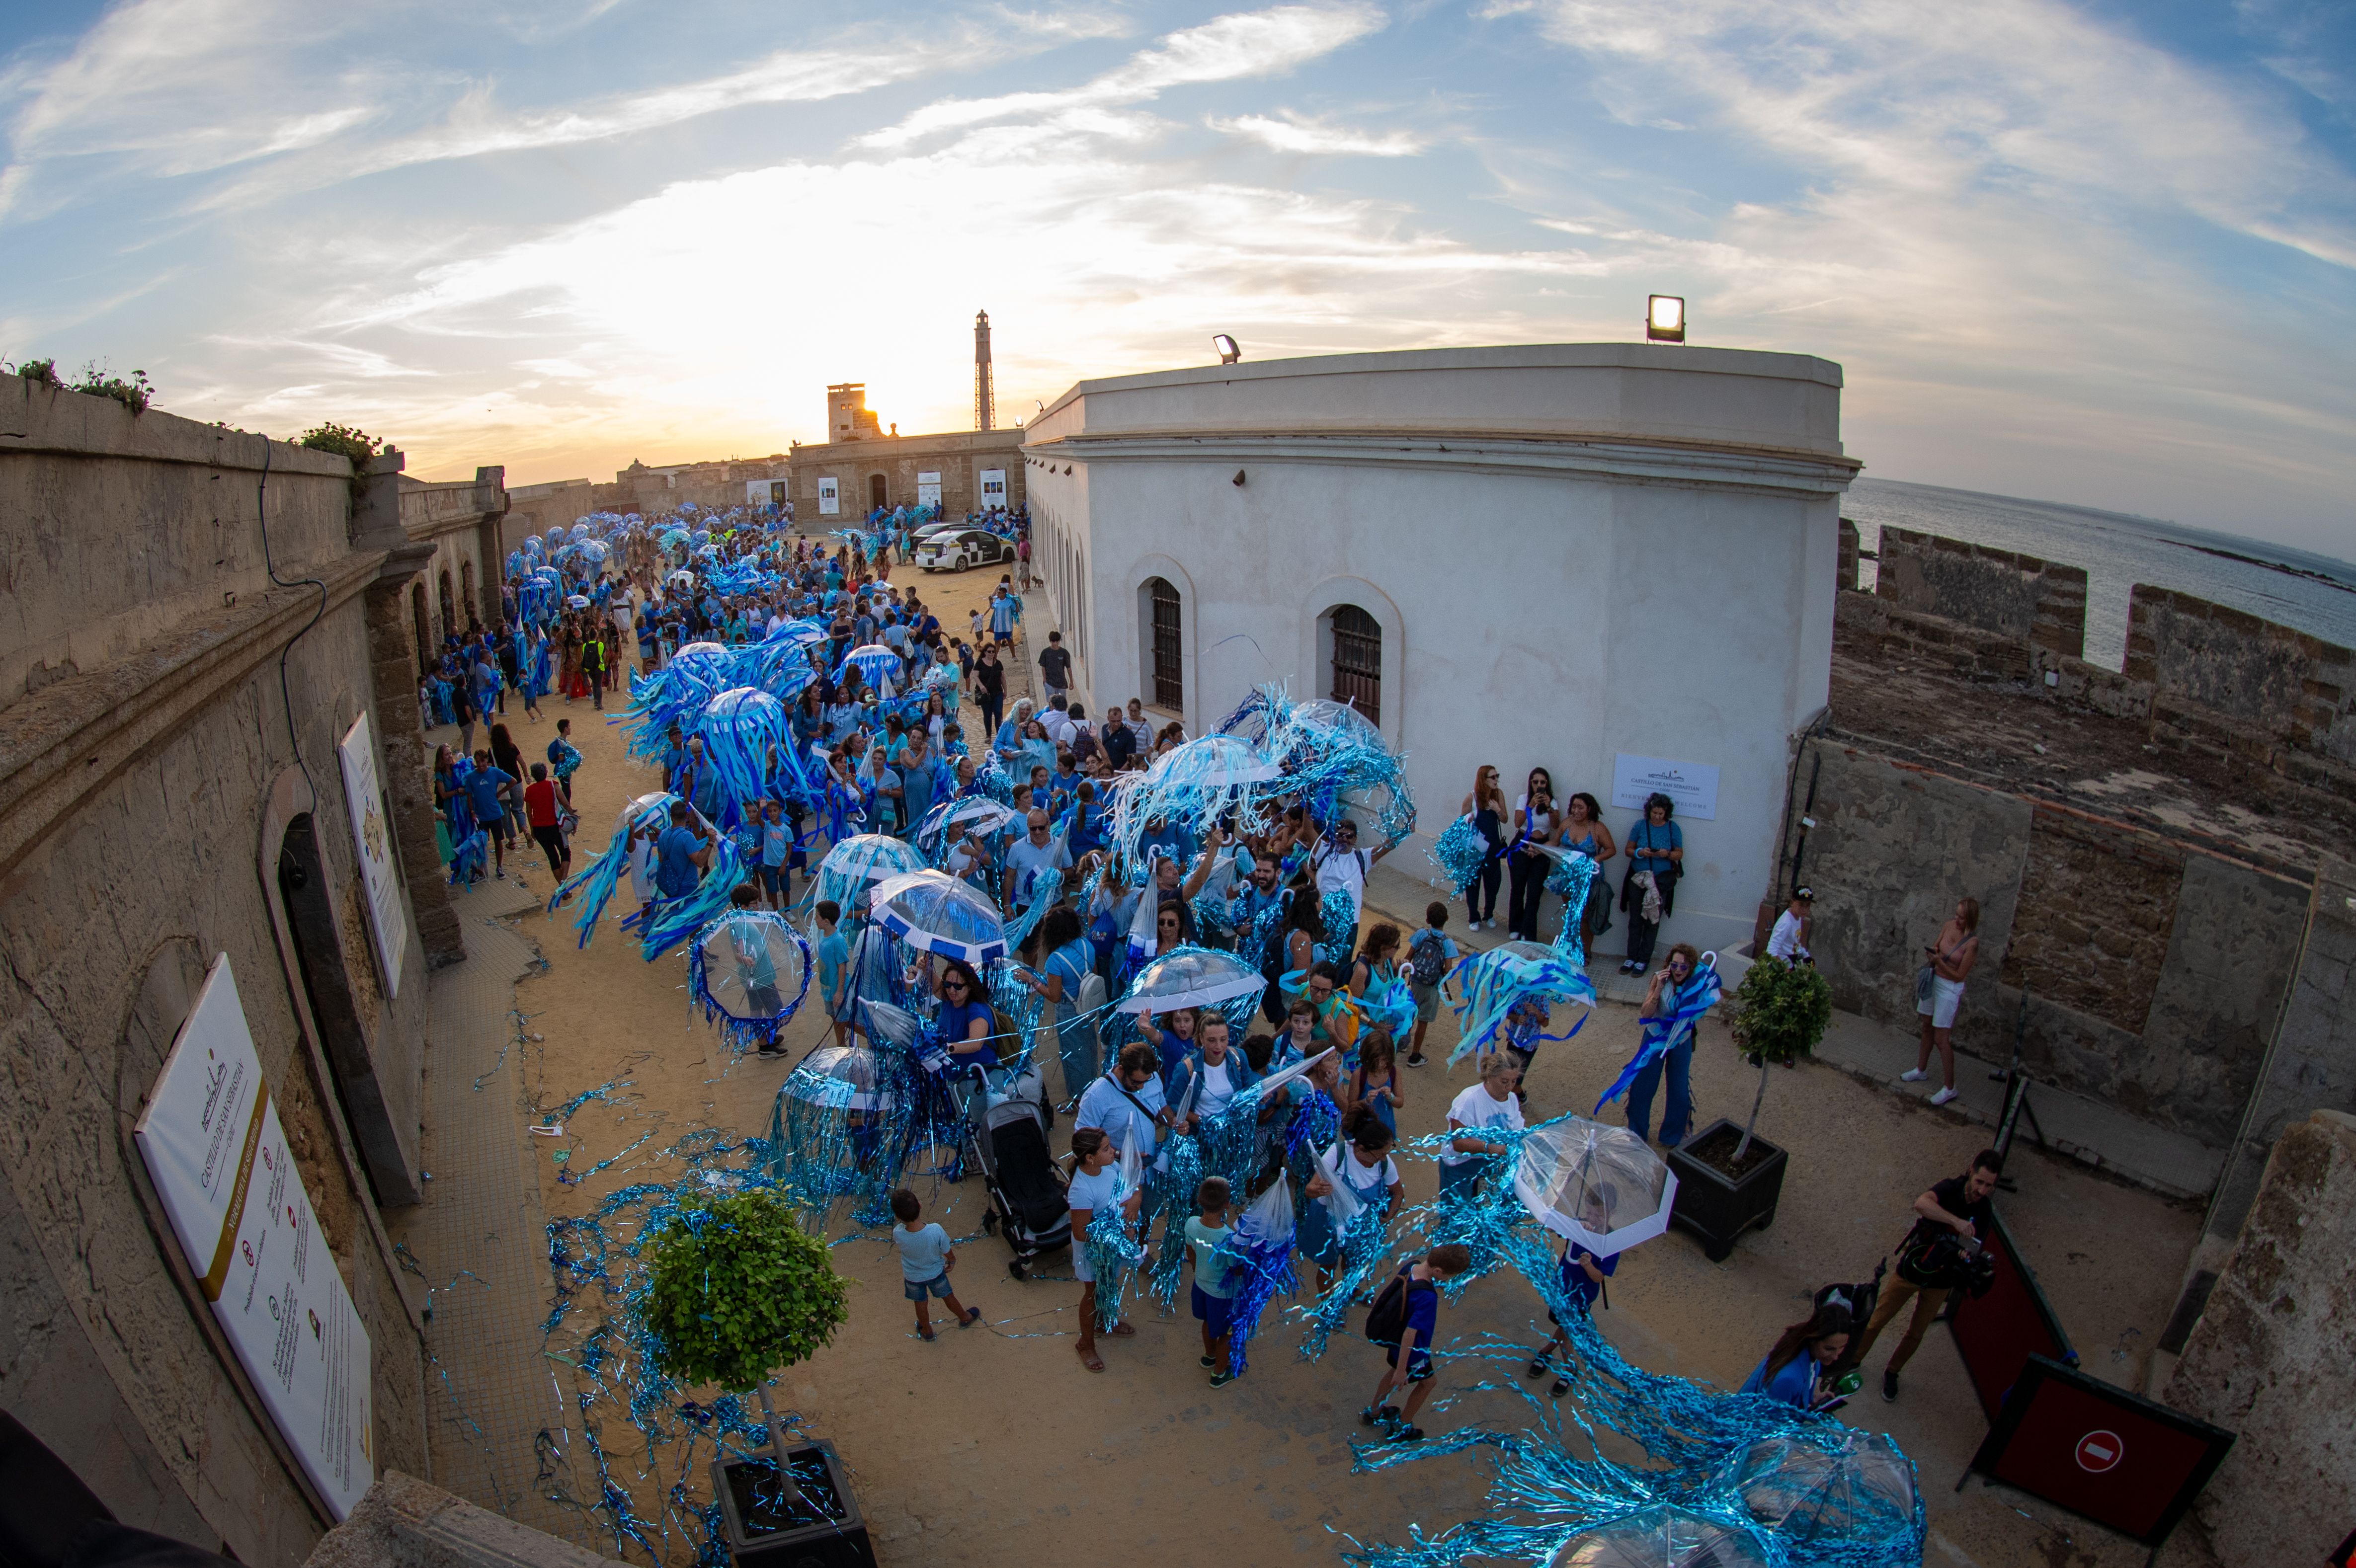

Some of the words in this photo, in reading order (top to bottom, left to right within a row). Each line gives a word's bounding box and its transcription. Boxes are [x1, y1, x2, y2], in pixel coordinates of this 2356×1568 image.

[1675, 800, 1706, 809] WELCOME
[201, 1135, 220, 1188] CASTILLO
[216, 1120, 224, 1141] DE
[220, 1101, 229, 1127] SAN
[226, 1058, 244, 1108] SEBASTIÁN
[227, 1126, 236, 1148] CÁDIZ
[245, 1118, 258, 1166] SEGURIDAD
[243, 1162, 248, 1178] DE
[229, 1176, 245, 1232] NORMATIVA
[252, 1275, 256, 1284] el
